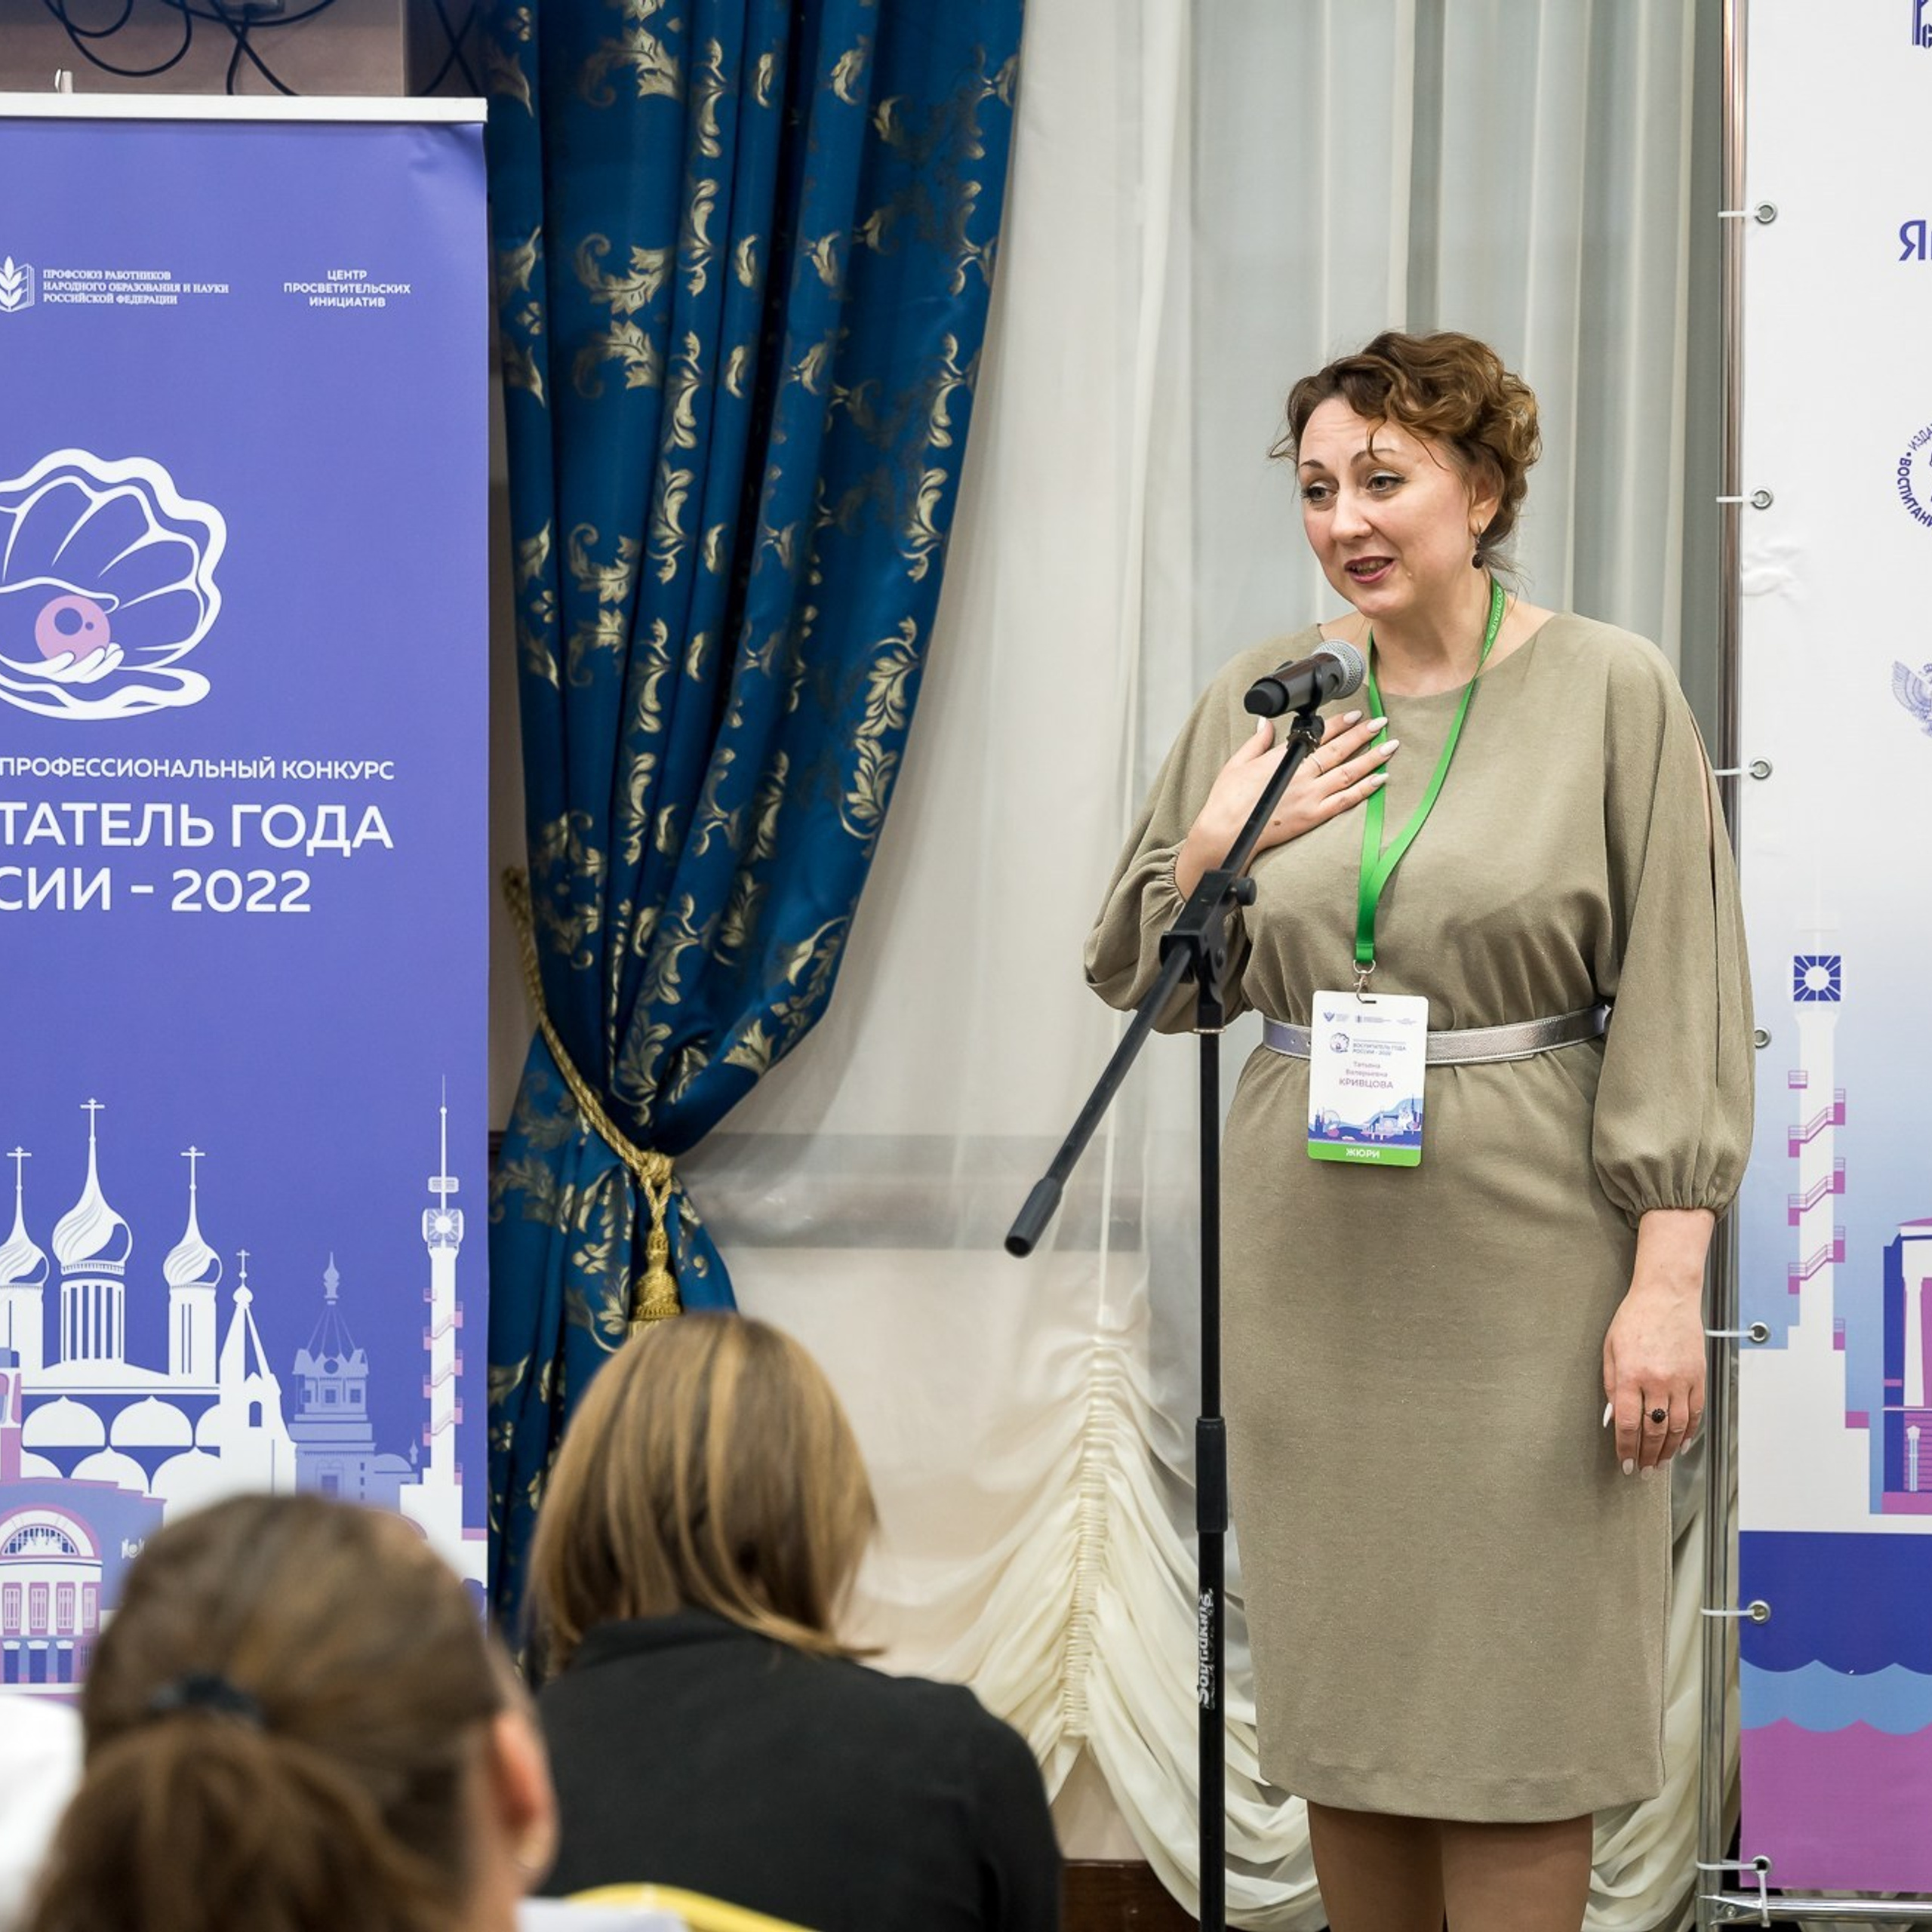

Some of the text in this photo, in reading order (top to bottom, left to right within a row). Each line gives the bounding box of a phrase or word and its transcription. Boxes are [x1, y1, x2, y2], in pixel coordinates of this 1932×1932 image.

[1898, 220, 1932, 261] Я
[43, 269, 171, 281] ПРОФСОЮЗ РАБОТНИКОВ
[327, 269, 368, 281] ЦЕНТР
[43, 281, 229, 294] НАРОДНОГО ОБРАЗОВАНИЯ И НАУКИ
[284, 282, 411, 294] ПРОСВЕТИТЕЛЬСКИХ
[43, 292, 177, 306] РОССИЙСКОЙ ФЕДЕРАЦИИ
[309, 297, 386, 309] ИНИЦИАТИВ
[1907, 423, 1932, 451] ИЗДА
[0, 756, 395, 780] ПРОФЕССИОНАЛЬНЫЙ КОНКУРС
[0, 801, 394, 857] ТАТЕЛЬ ГОДА
[171, 869, 312, 912] 2022
[1339, 1078, 1394, 1089] КРИВЦОВА
[1346, 1148, 1381, 1159] ЖЮРИ
